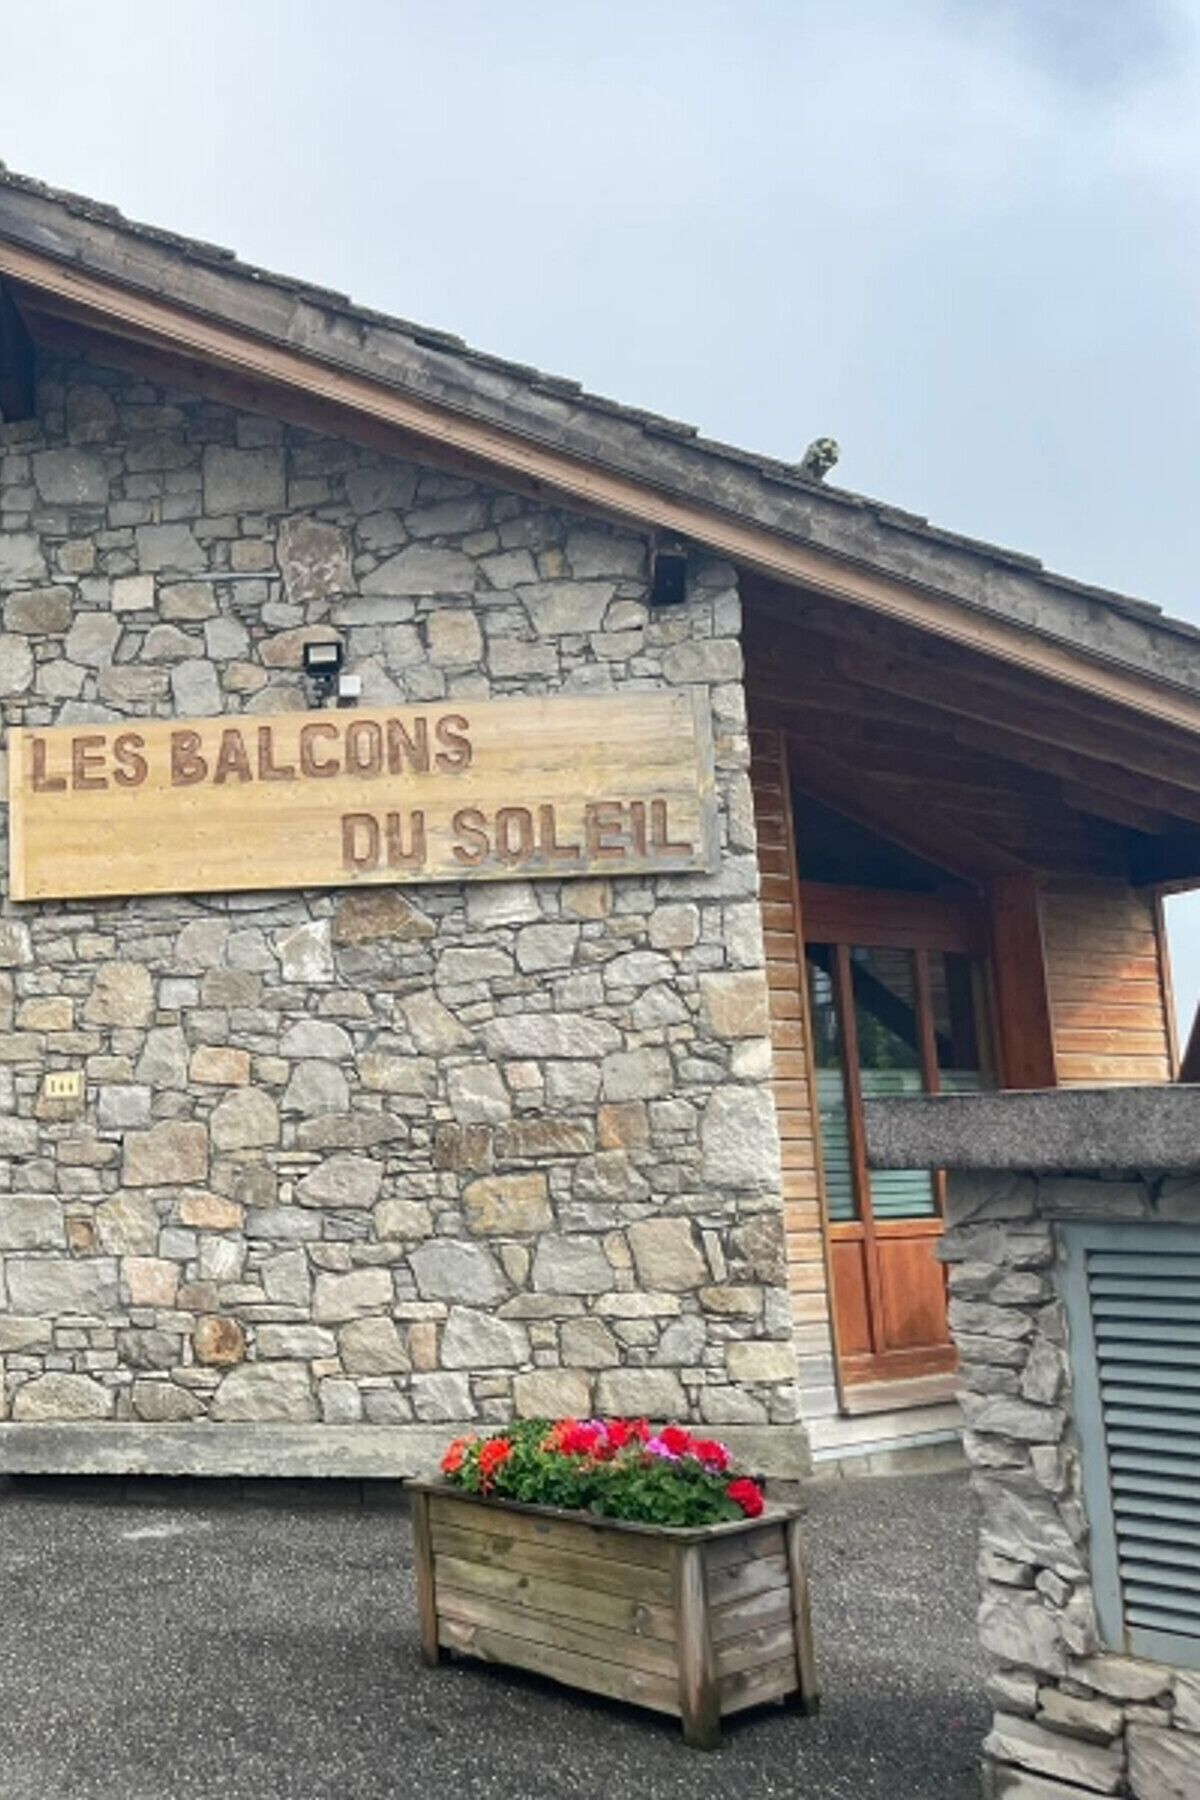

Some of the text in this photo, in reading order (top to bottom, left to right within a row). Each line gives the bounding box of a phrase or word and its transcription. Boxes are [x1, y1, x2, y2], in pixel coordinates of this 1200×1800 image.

[31, 714, 474, 793] LES BALCONS
[340, 799, 693, 871] DU SOLEIL
